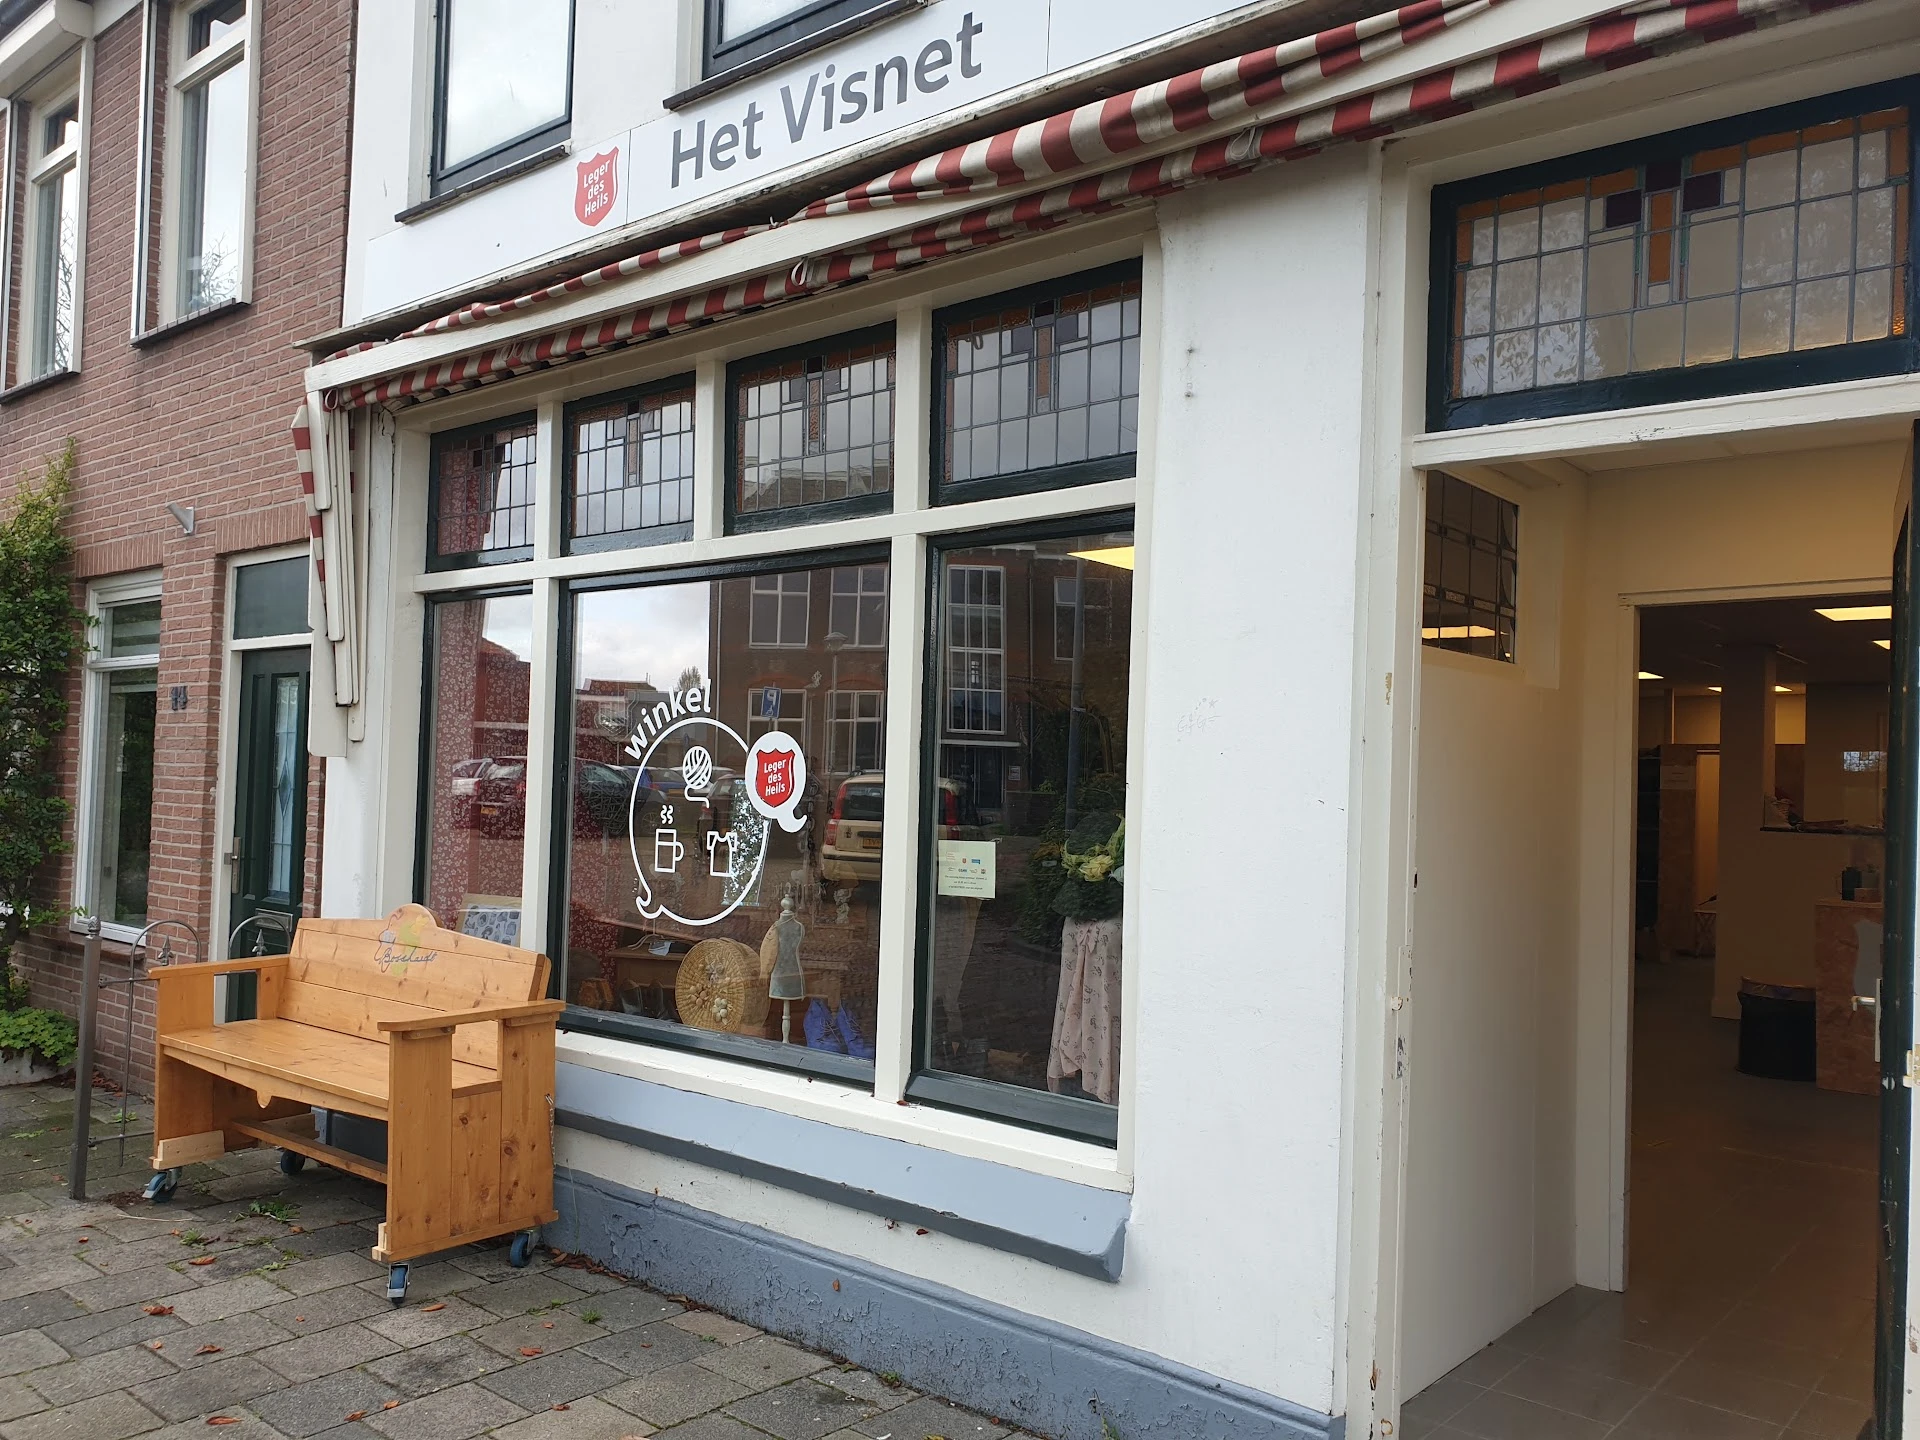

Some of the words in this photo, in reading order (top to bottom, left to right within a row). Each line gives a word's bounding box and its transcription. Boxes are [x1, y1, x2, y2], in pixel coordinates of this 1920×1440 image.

[671, 101, 764, 189] Het
[780, 12, 983, 143] Visnet
[583, 160, 610, 188] Leger
[588, 180, 604, 199] des
[584, 193, 608, 218] Heils
[624, 679, 711, 760] winkel
[764, 759, 786, 773] Leger
[765, 782, 785, 796] Heils
[768, 773, 782, 783] des
